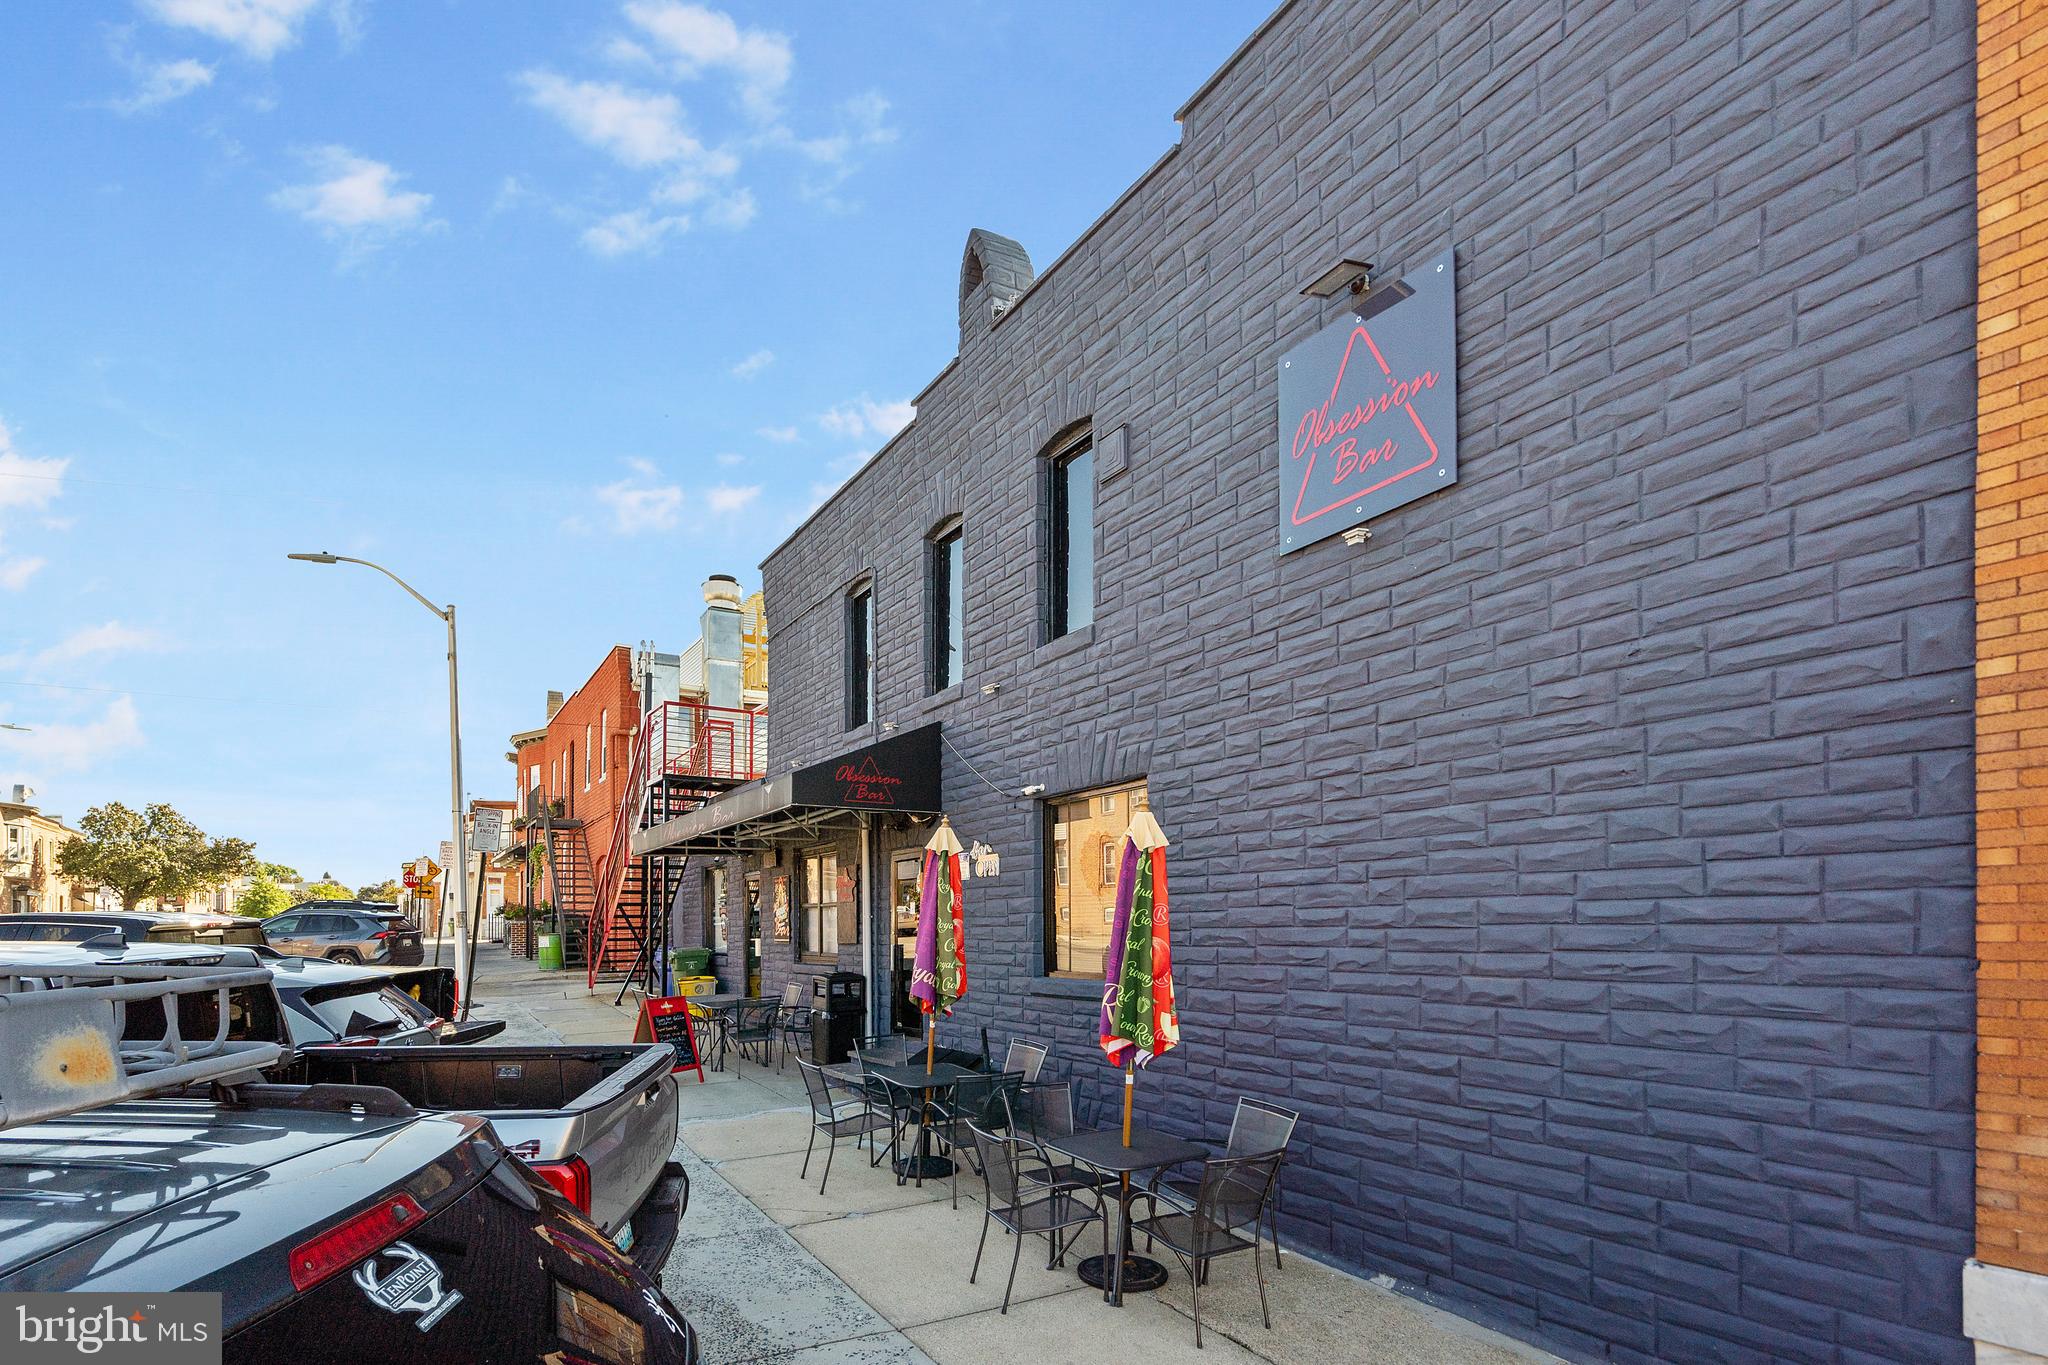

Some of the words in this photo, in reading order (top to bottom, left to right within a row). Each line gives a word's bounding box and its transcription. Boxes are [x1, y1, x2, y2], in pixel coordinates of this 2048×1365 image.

[1292, 370, 1439, 459] Obsession
[1331, 437, 1399, 485] Bar
[835, 765, 902, 785] Obsession
[855, 783, 885, 801] Bar
[404, 874, 421, 883] STO
